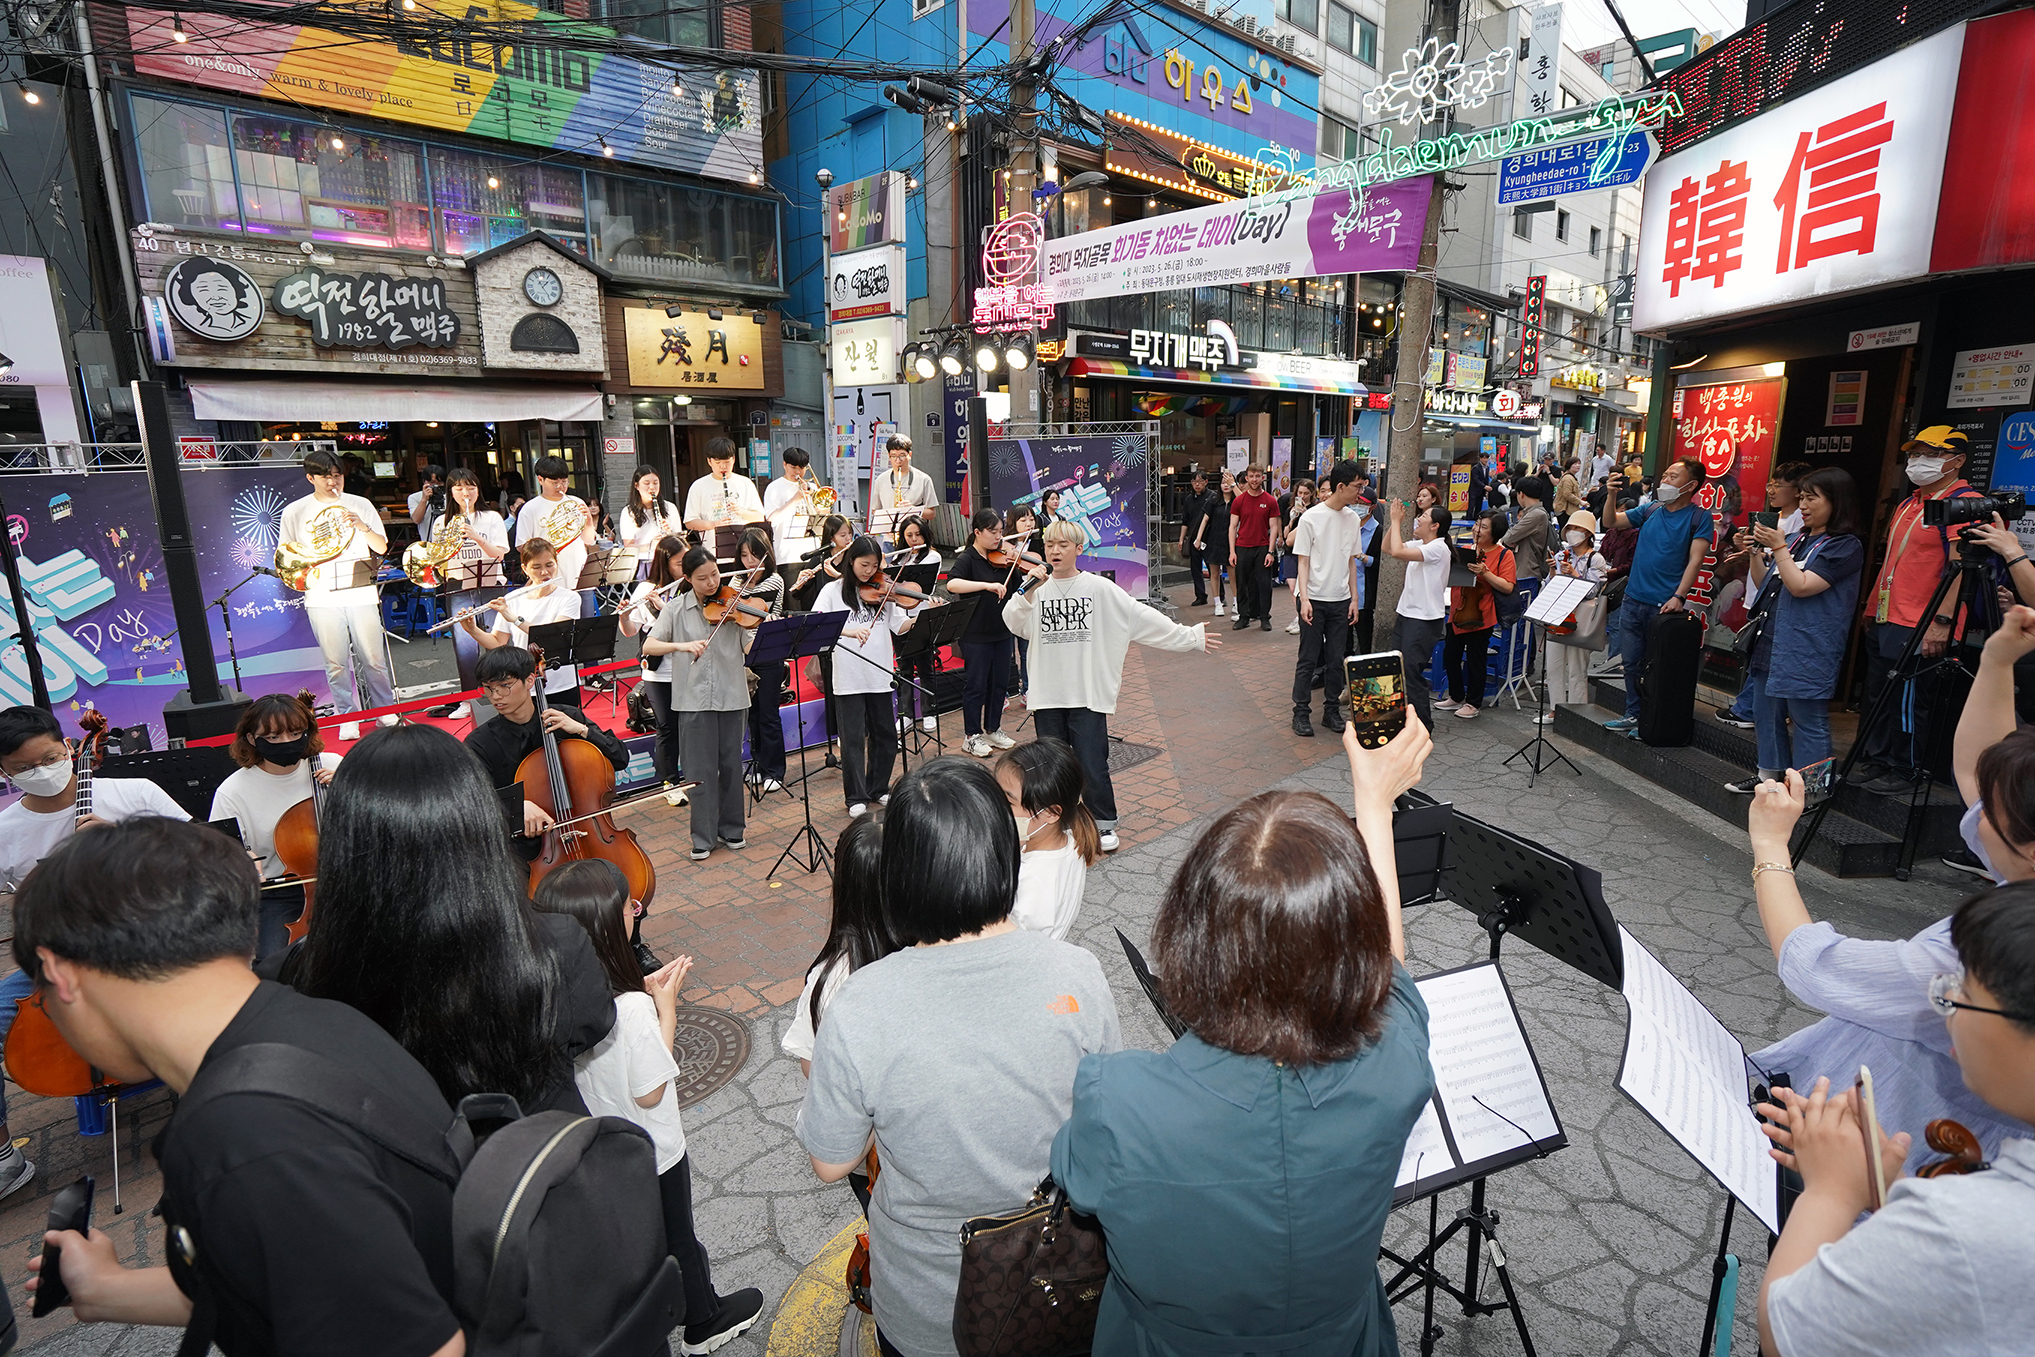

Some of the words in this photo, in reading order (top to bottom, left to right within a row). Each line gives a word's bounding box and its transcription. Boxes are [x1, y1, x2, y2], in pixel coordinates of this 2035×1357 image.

[184, 53, 260, 81] one&only
[269, 71, 313, 90] warm
[317, 79, 329, 92] &
[334, 82, 374, 102] lovely
[378, 92, 413, 109] place
[1165, 48, 1253, 115] 하우스
[645, 136, 668, 150] Sour
[1504, 166, 1579, 188] Kyungheedae-ro
[1661, 99, 1896, 300] 韓信
[838, 208, 883, 233] LoCoMo
[138, 237, 159, 251] 40
[1048, 249, 1074, 276] 경희대
[1073, 241, 1112, 271] 먹자골목
[1110, 229, 1153, 263] 회기동
[1023, 282, 1054, 303] 여는
[337, 322, 378, 340] 1982
[410, 312, 455, 343] 맥주
[835, 328, 855, 336] IZAKAYA
[420, 355, 478, 365] 02)6369-9433
[1129, 329, 1225, 371] 무지개맥주
[1971, 350, 2001, 364] 영업시간
[2002, 350, 2020, 360] 안내
[1433, 389, 1480, 416] 바다내음
[1498, 394, 1514, 411] 회
[1699, 384, 1753, 414] 백종원의
[1451, 471, 1470, 484] 도다리
[1091, 511, 1123, 532] Day
[1041, 597, 1093, 617] HIDE
[72, 608, 149, 655] Day
[1041, 613, 1090, 633] SEEK
